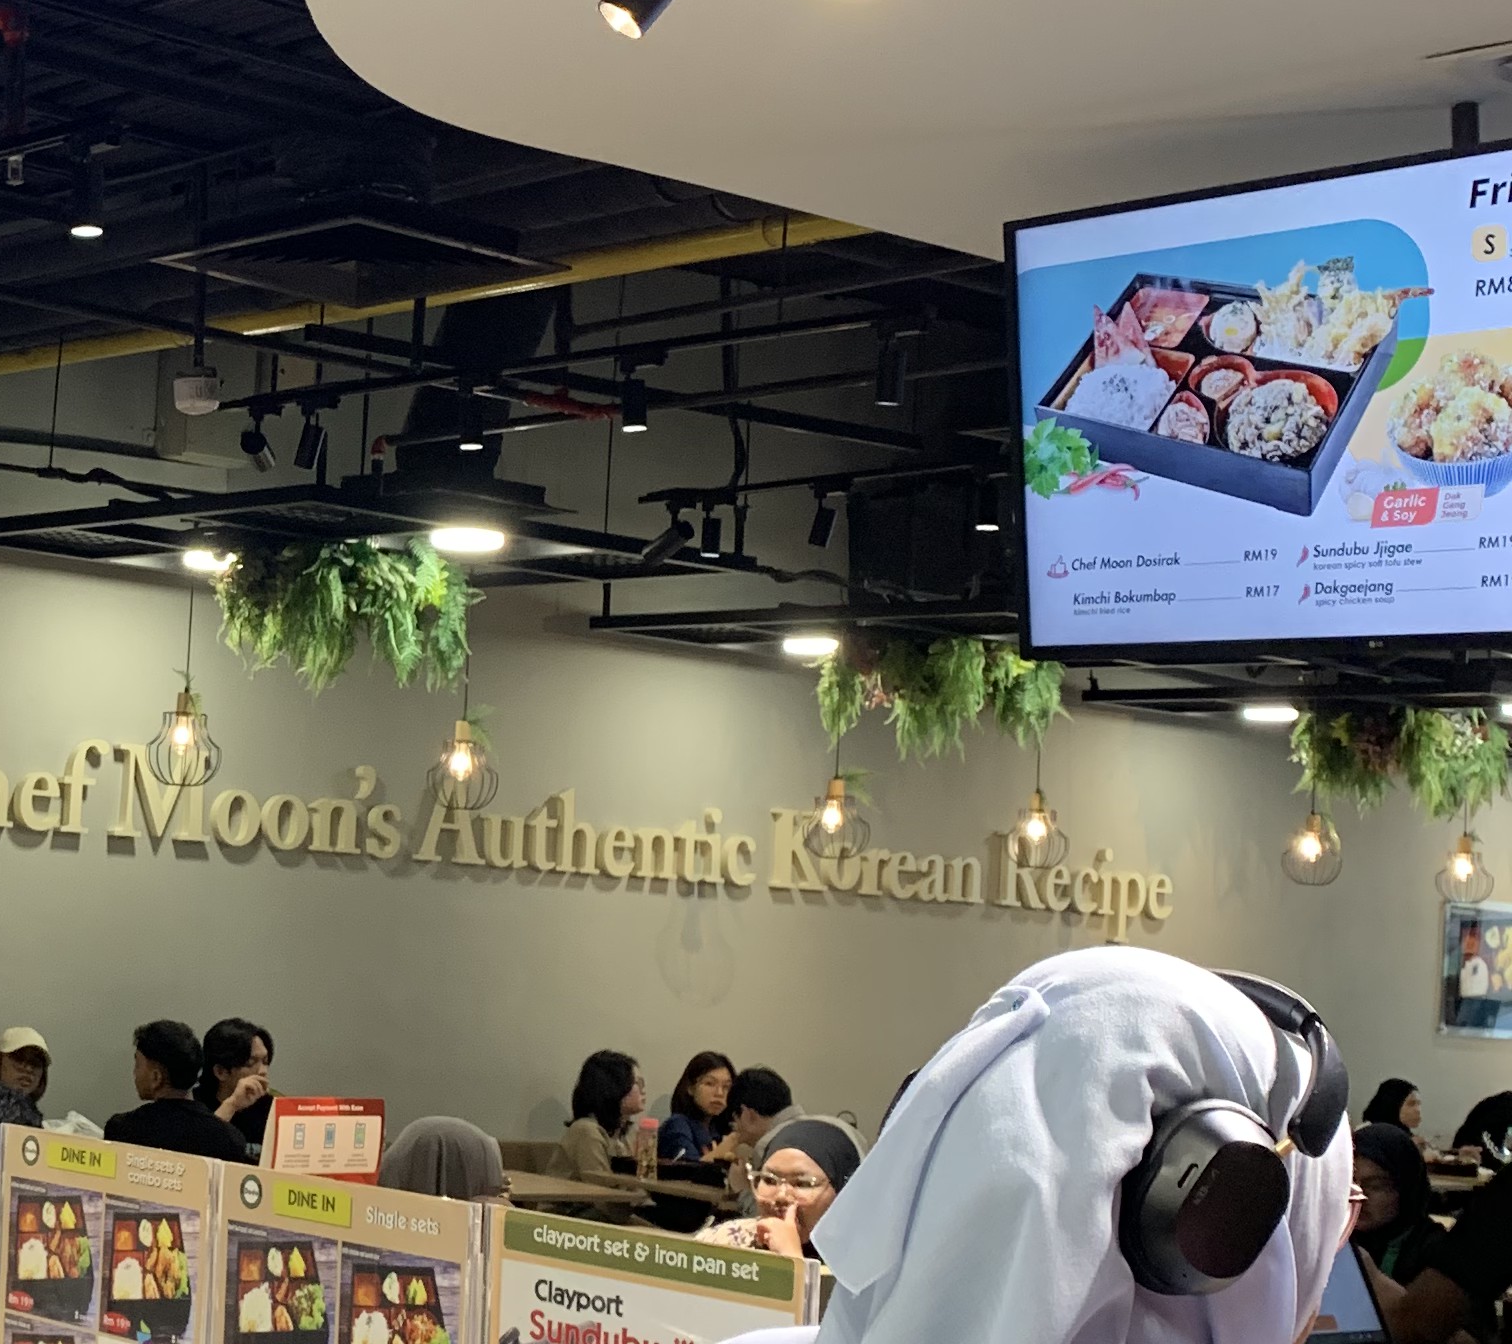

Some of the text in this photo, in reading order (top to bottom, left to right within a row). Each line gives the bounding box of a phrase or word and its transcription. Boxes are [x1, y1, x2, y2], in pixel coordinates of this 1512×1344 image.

[1483, 234, 1497, 256] S
[1383, 493, 1426, 509] Garlic
[1380, 509, 1417, 523] & Soy
[1071, 548, 1278, 571] Chef Moon Dosirak RM19
[1313, 541, 1370, 559] Sundubu
[1373, 540, 1413, 559] Jjigae
[1073, 585, 1280, 606] Kimchi Bokumbap RM17
[1314, 579, 1394, 598] Dakgaejang
[412, 776, 757, 888] Authentic
[769, 807, 985, 905] Korean
[1002, 830, 1174, 943] Recipe
[61, 1146, 102, 1167] DINE IN
[155, 1160, 175, 1174] sets
[128, 1171, 183, 1192] combo sets
[288, 1189, 336, 1213] DINE IN
[365, 1206, 441, 1236] Single sets
[533, 1224, 760, 1283] clayport set & iron pan set
[534, 1278, 624, 1318] Clayport
